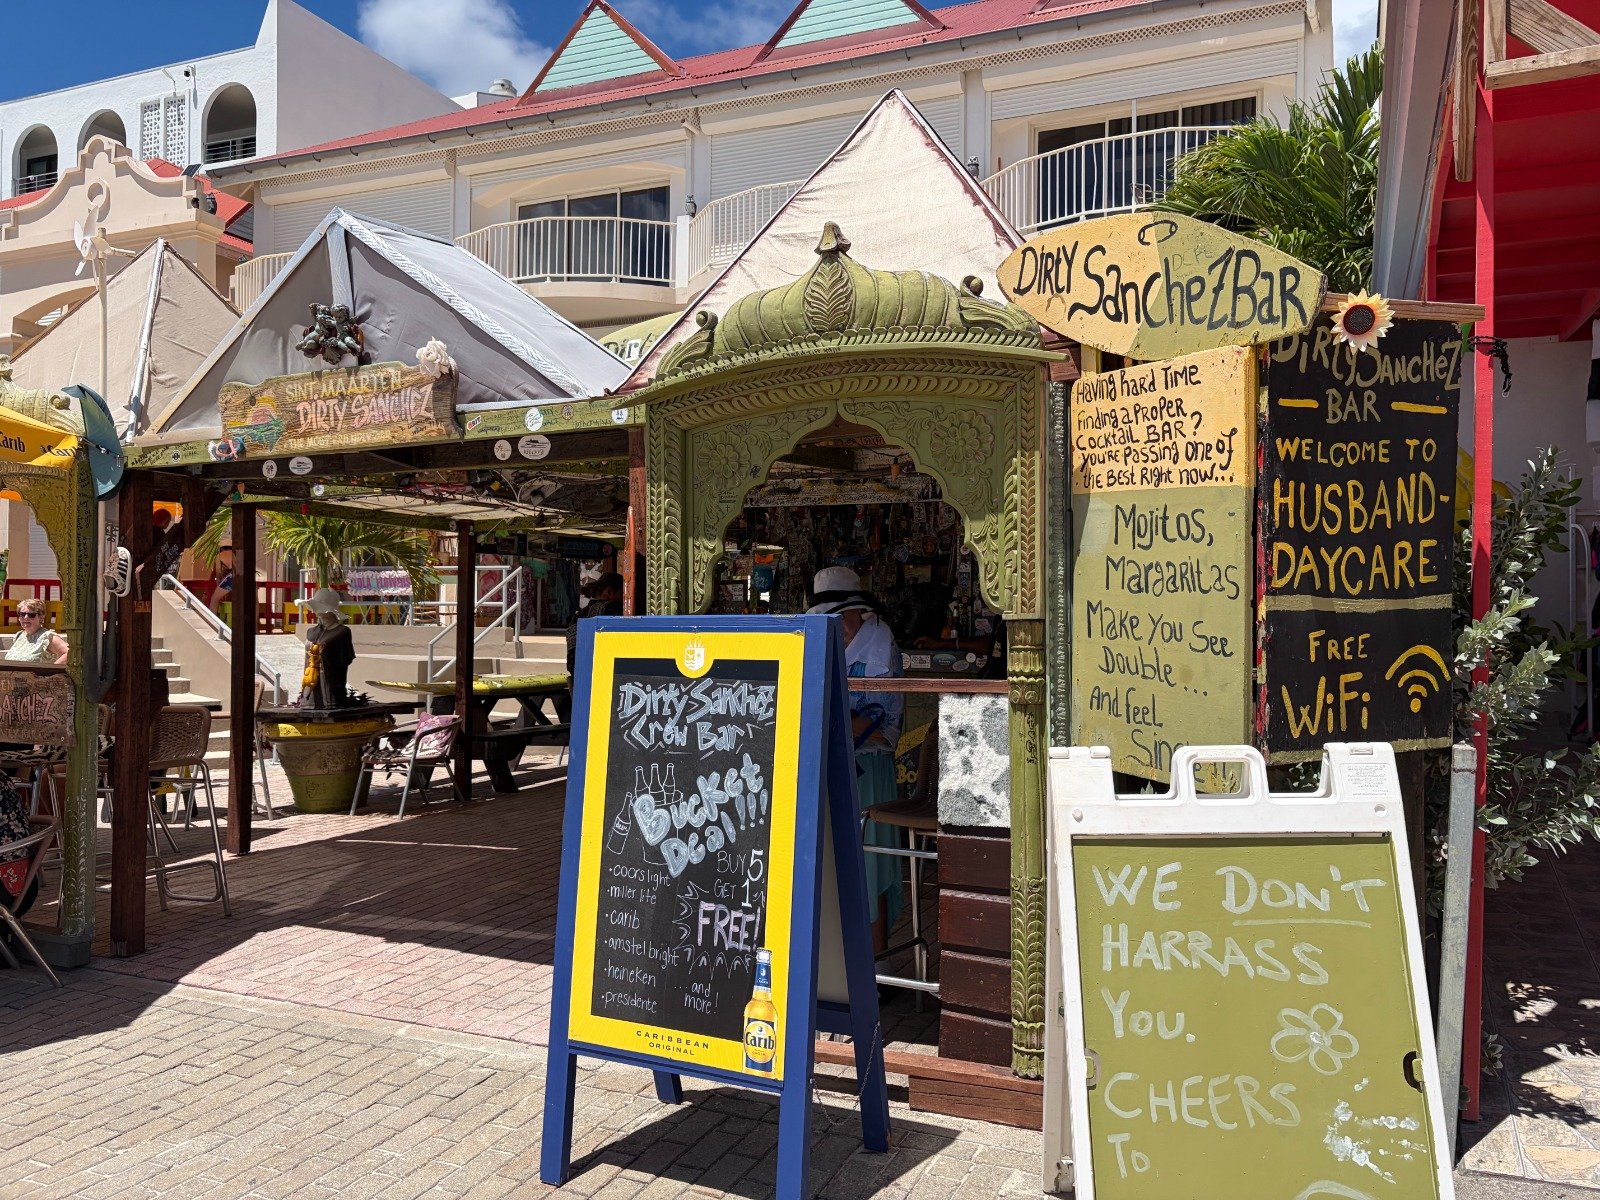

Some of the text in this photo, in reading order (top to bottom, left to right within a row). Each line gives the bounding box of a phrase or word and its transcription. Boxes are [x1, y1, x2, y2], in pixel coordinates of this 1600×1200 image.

[321, 367, 402, 398] MAARTEN
[296, 394, 347, 434] DIRTY
[351, 383, 435, 429] SANCHEZ
[1325, 388, 1382, 424] BAR
[1275, 436, 1438, 468] WELCOME TO
[1271, 539, 1438, 596] DAYCARE
[1308, 629, 1371, 663] FREE
[619, 683, 689, 726] Dirty
[1281, 671, 1371, 739] WiFi
[697, 722, 746, 752] Bar
[613, 864, 671, 891] coors light
[716, 849, 764, 882] BUY 5
[639, 888, 657, 905] lite
[713, 878, 753, 907] GET 1
[1092, 861, 1182, 911] WE
[610, 908, 641, 930] carib
[698, 901, 762, 951] FREE!
[608, 936, 680, 969] amstel bright
[1100, 923, 1330, 986] HARRASS
[636, 1030, 710, 1050] CARIBBEAN
[648, 1042, 695, 1056] ORIGINAL
[745, 1031, 775, 1050] Carib
[1104, 1071, 1301, 1132] CHEERS
